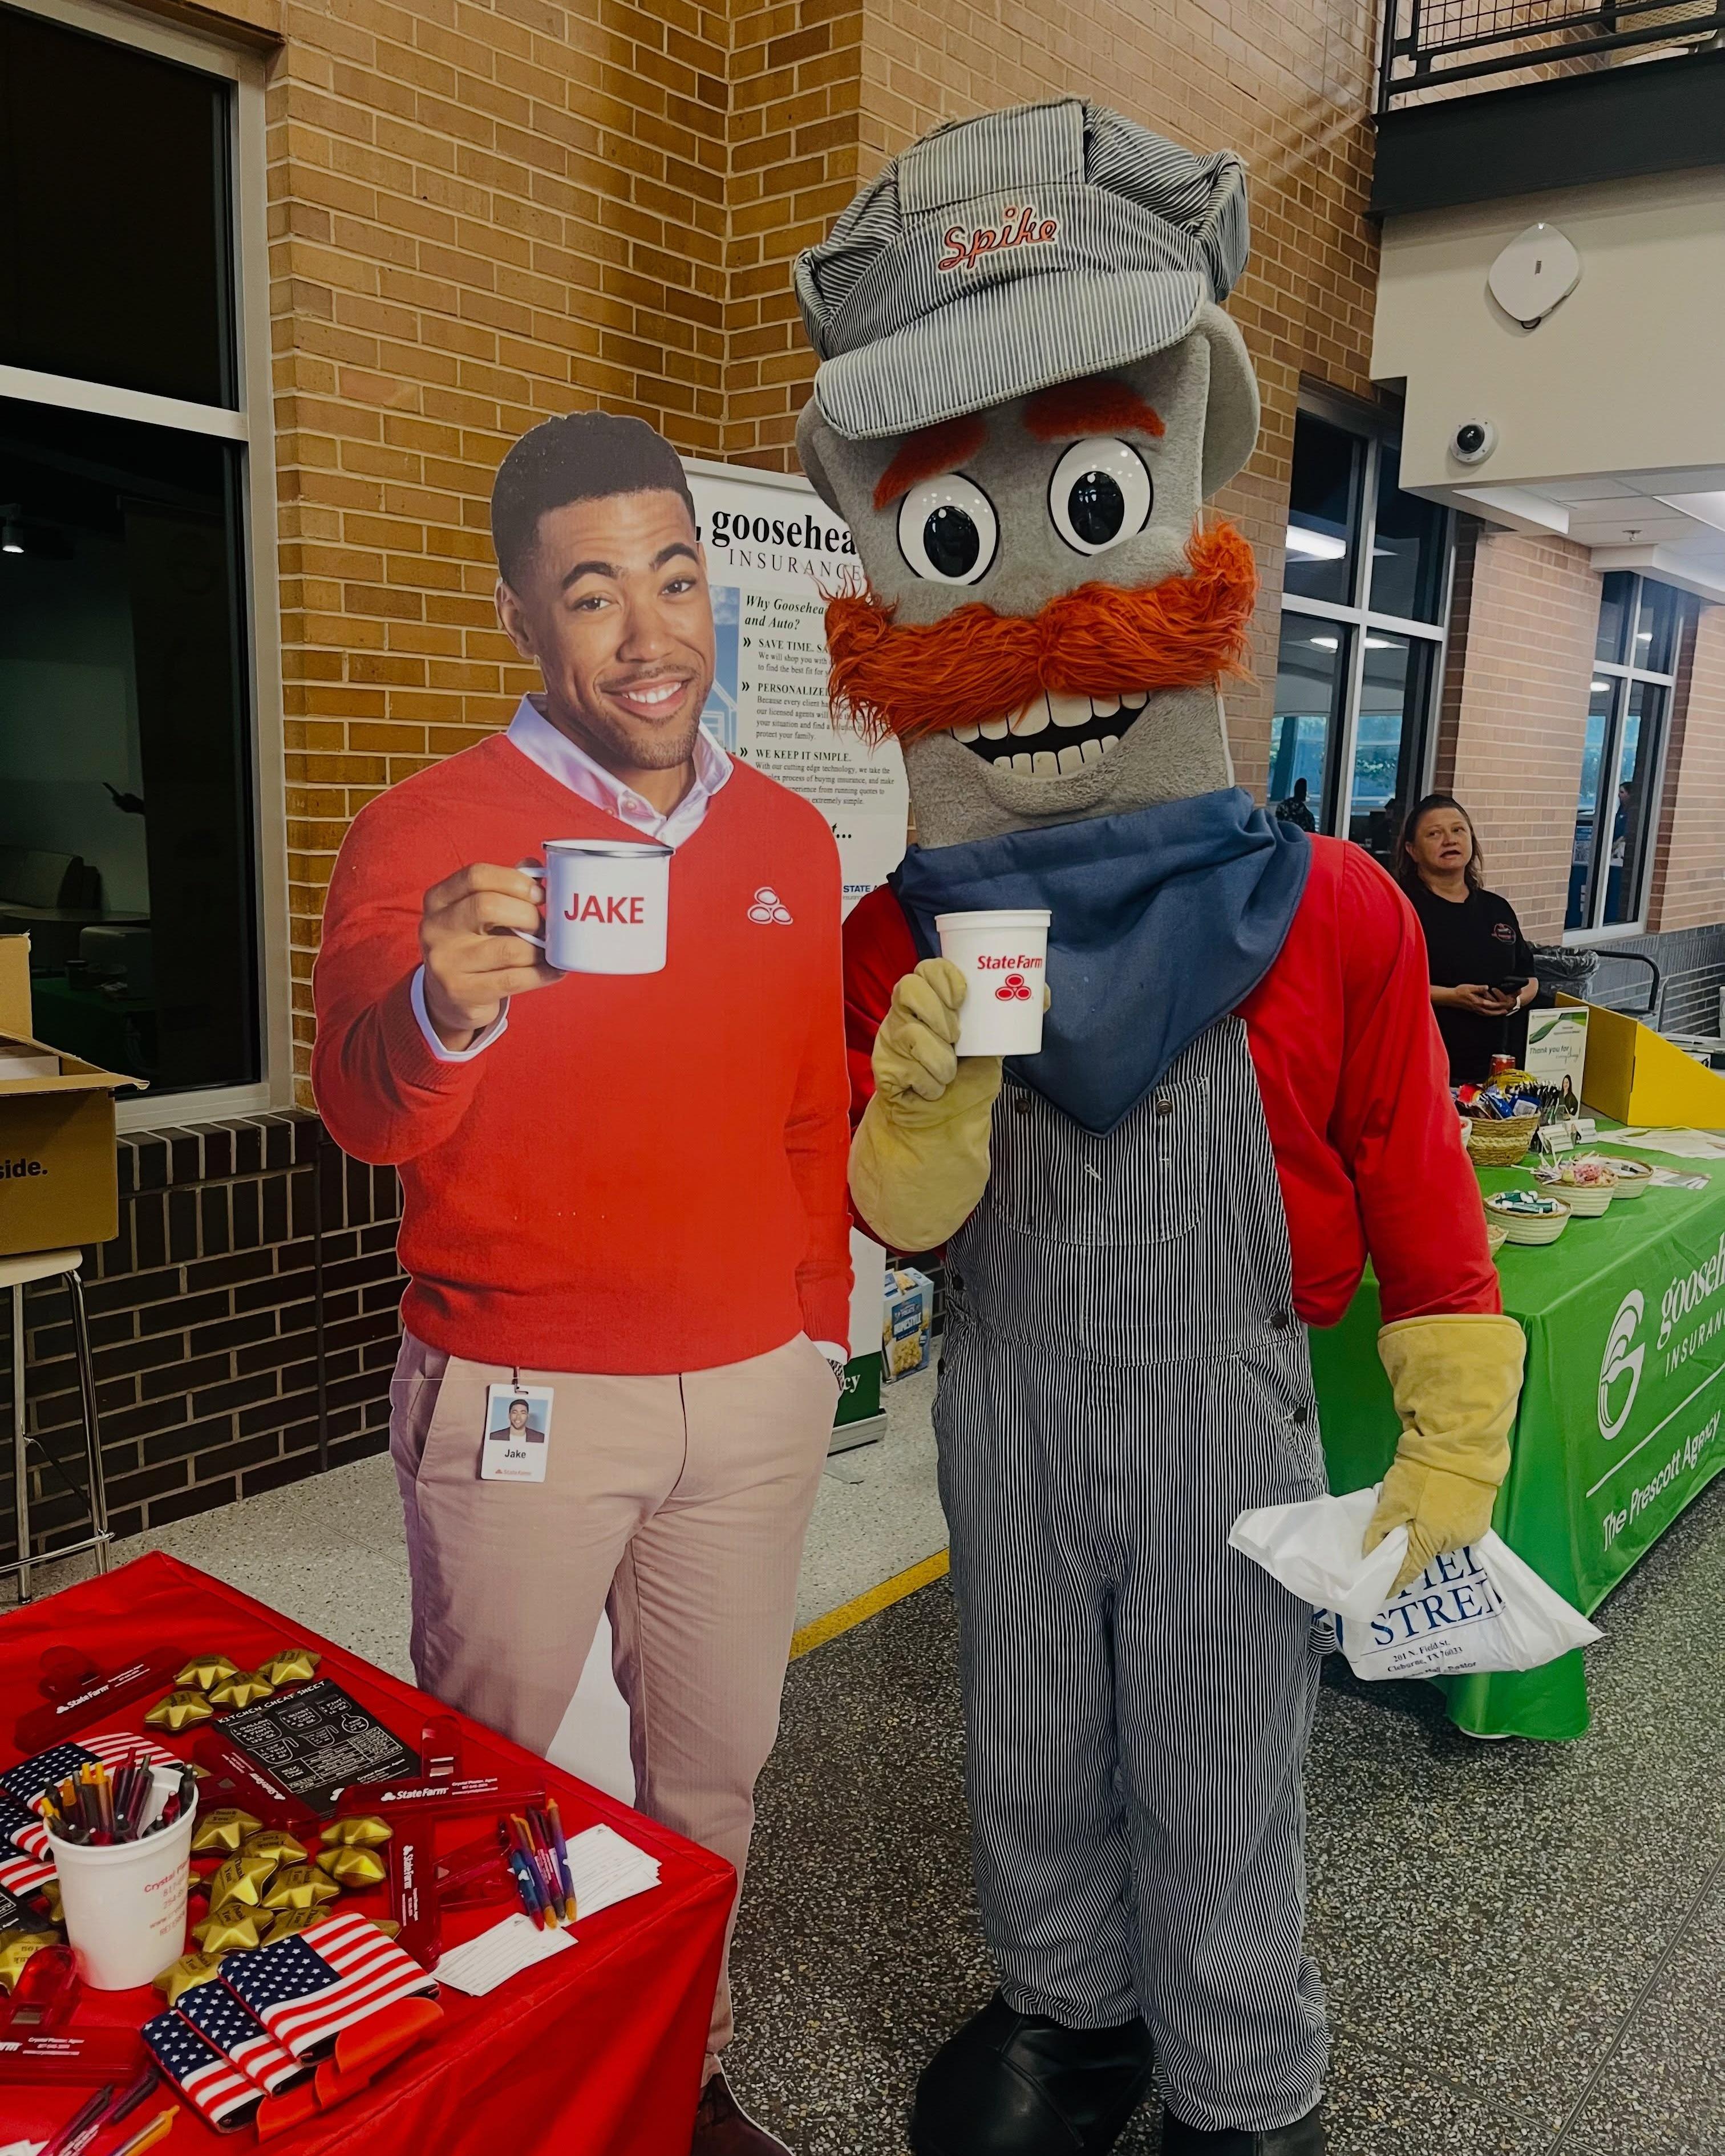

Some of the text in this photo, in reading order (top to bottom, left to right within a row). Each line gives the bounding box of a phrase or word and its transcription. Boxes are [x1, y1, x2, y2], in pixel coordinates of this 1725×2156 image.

[938, 207, 1057, 270] Spike
[712, 511, 857, 555] goosehea
[746, 595, 770, 611] Why
[745, 615, 800, 630] and Auto?
[759, 639, 784, 650] SAVE
[784, 655, 799, 664] shop
[758, 696, 782, 704] Because
[784, 699, 800, 707] every
[756, 749, 852, 761] WE KEEP IT SIMPLE.
[806, 764, 820, 773] edge
[564, 893, 645, 924] JAKE
[1666, 1308, 1725, 1377] INSURAN
[504, 1449, 526, 1458] Jake
[1603, 1409, 1720, 1552] The Prescott Agency
[1393, 1653, 1407, 1662] 201
[1419, 1642, 1438, 1654] Field
[217, 1681, 325, 1724] KITCHEN CHEAT SHEET
[144, 1870, 175, 1892] Crystal
